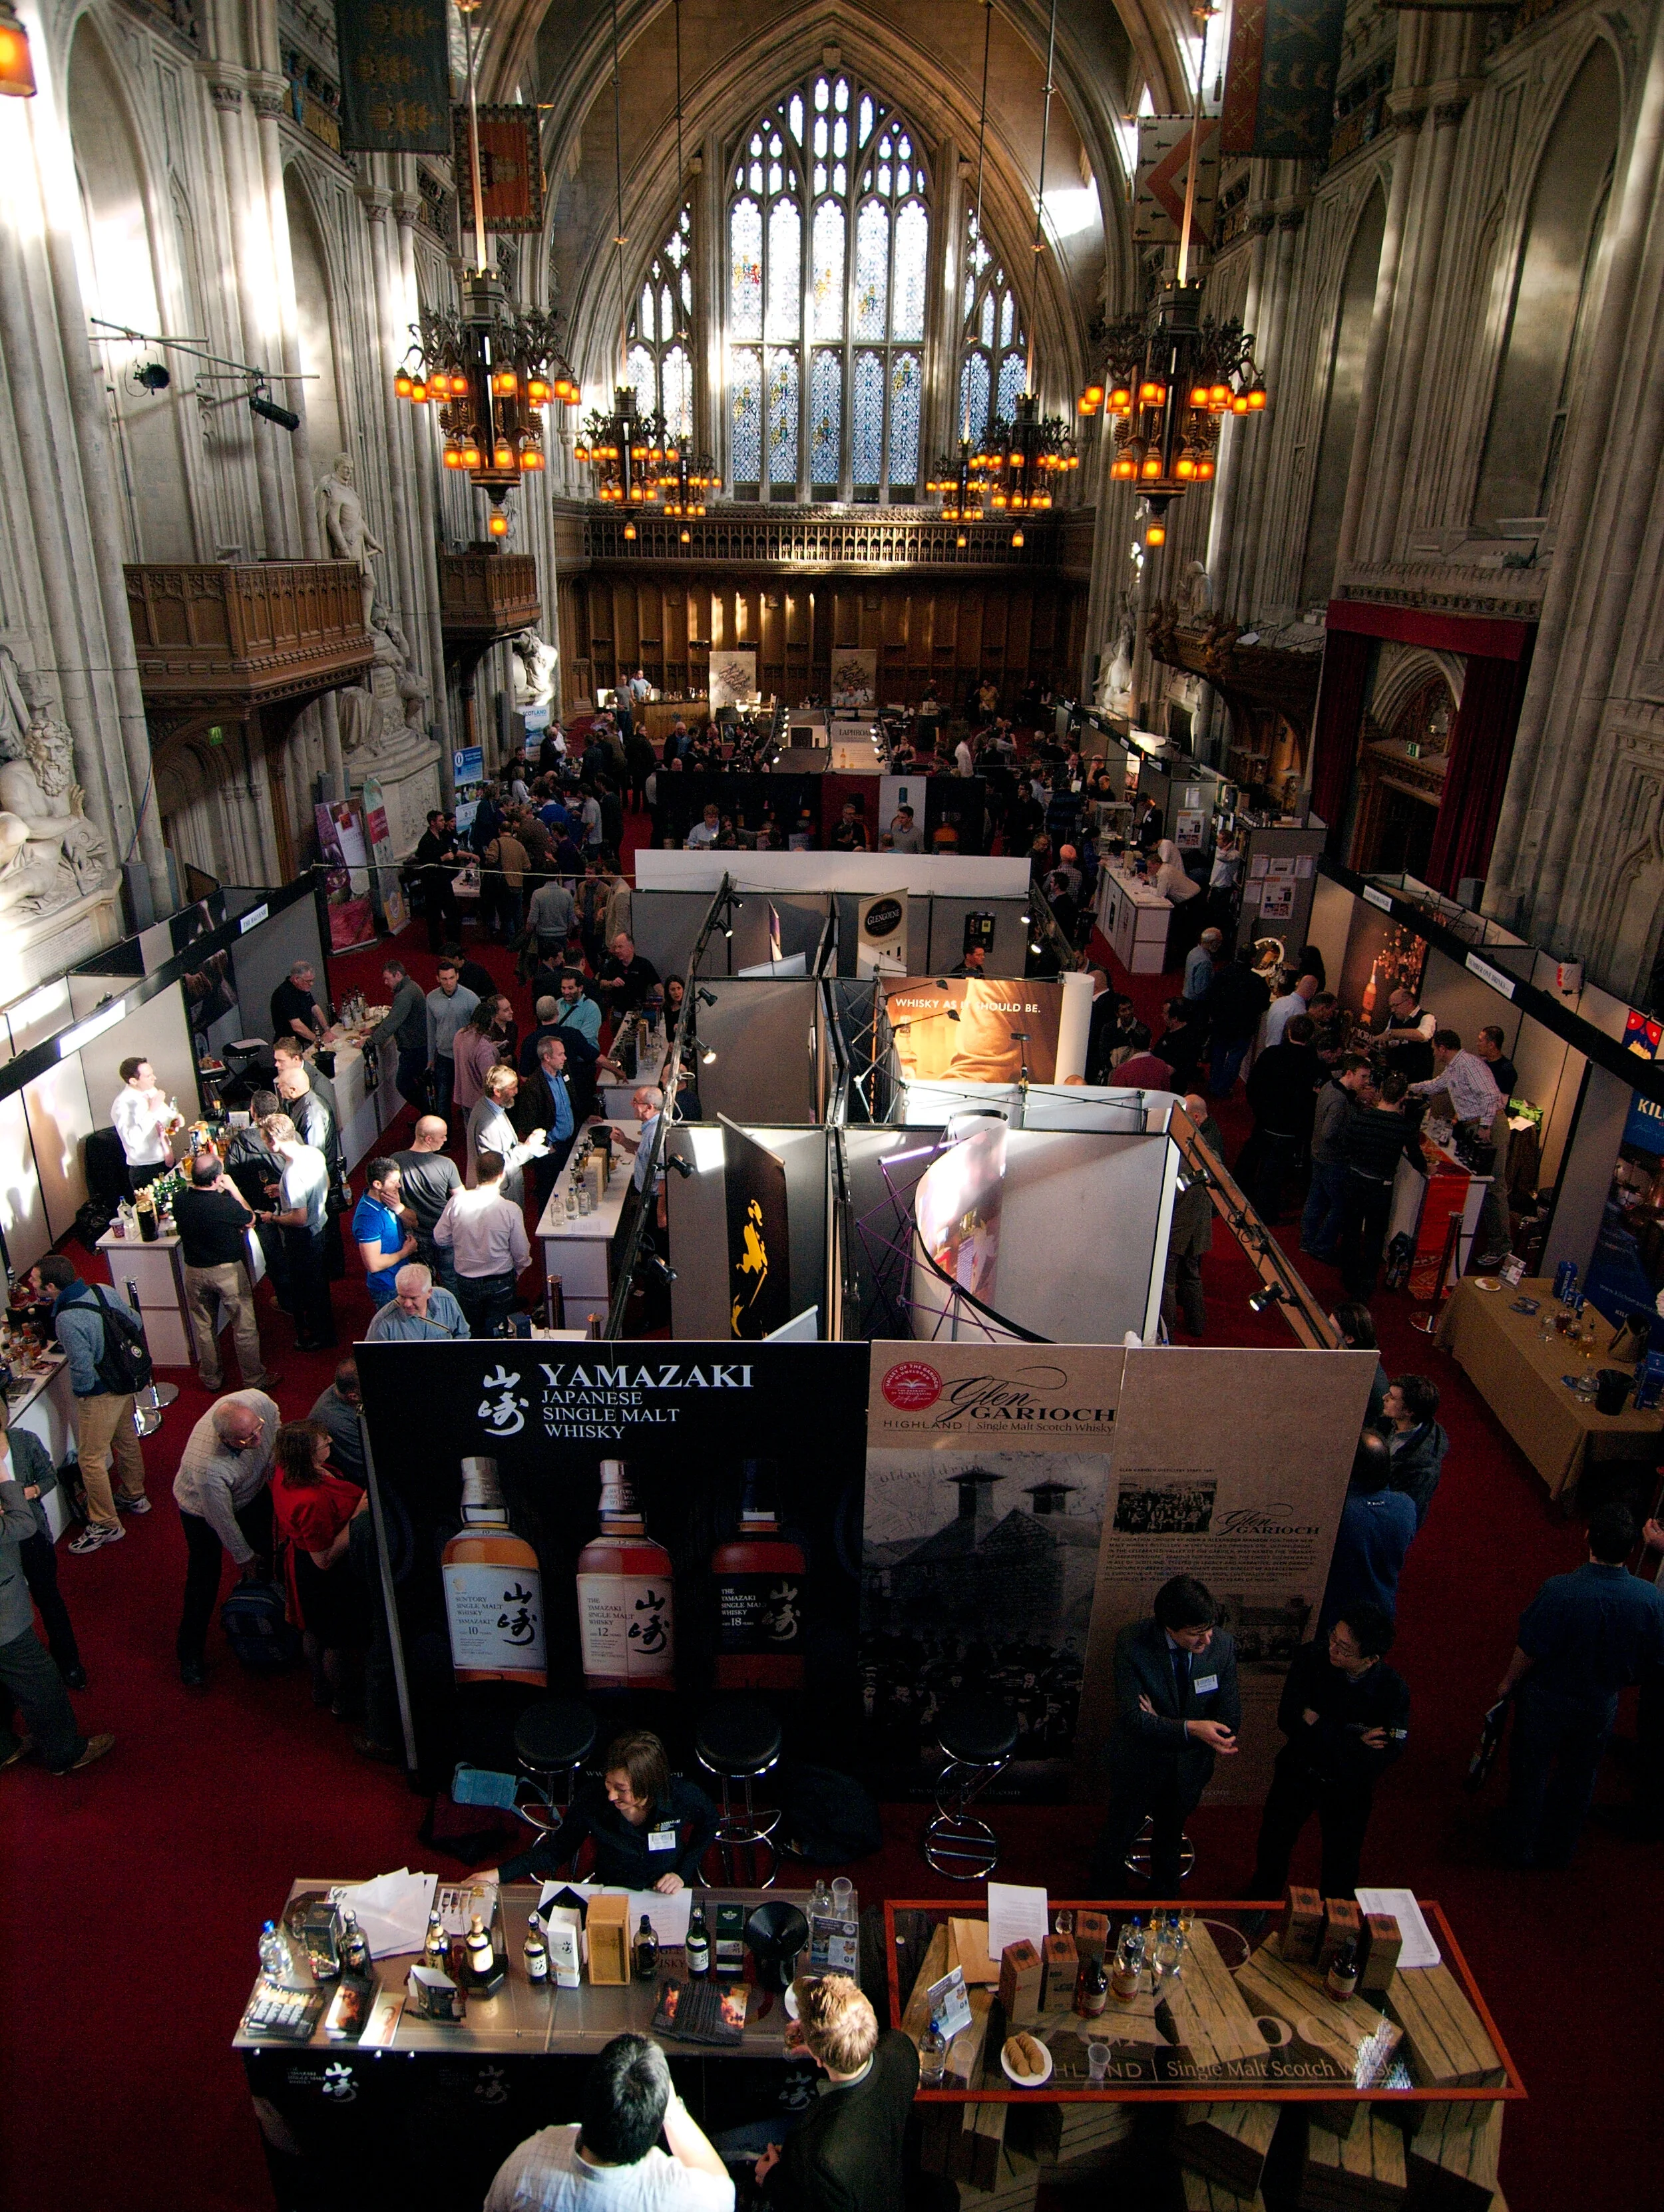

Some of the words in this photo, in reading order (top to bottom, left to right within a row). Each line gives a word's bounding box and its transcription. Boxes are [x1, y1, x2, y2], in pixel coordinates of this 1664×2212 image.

[867, 909, 901, 926] GLENGOYNE
[896, 998, 939, 1009] WHISKY
[942, 1000, 956, 1009] AS
[976, 1001, 1020, 1012] SHOULD
[1025, 1004, 1041, 1013] BE.
[1637, 1098, 1664, 1119] KIL
[538, 1364, 753, 1387] YAMAZAKI
[478, 1365, 528, 1435] 山崎
[542, 1390, 642, 1405] JAPANESE
[936, 1371, 1053, 1422] Glen
[543, 1407, 616, 1421] SINGLE
[622, 1409, 679, 1421] MALT
[971, 1407, 1116, 1421] GARIOCH
[544, 1423, 626, 1439] WHISKY
[883, 1420, 962, 1429] HIGHLAND
[976, 1422, 1008, 1431] Single
[1010, 1423, 1033, 1431] Malt
[1036, 1423, 1072, 1431] Scotch
[1075, 1423, 1114, 1434] Whisky
[1217, 1505, 1288, 1536] Glen
[731, 1617, 742, 1626] 18
[469, 1626, 479, 1635] 10
[598, 1627, 608, 1636] 12
[1169, 2060, 1217, 2080] Single
[1222, 2060, 1269, 2078] Malt
[1273, 2060, 1333, 2078] Scotch
